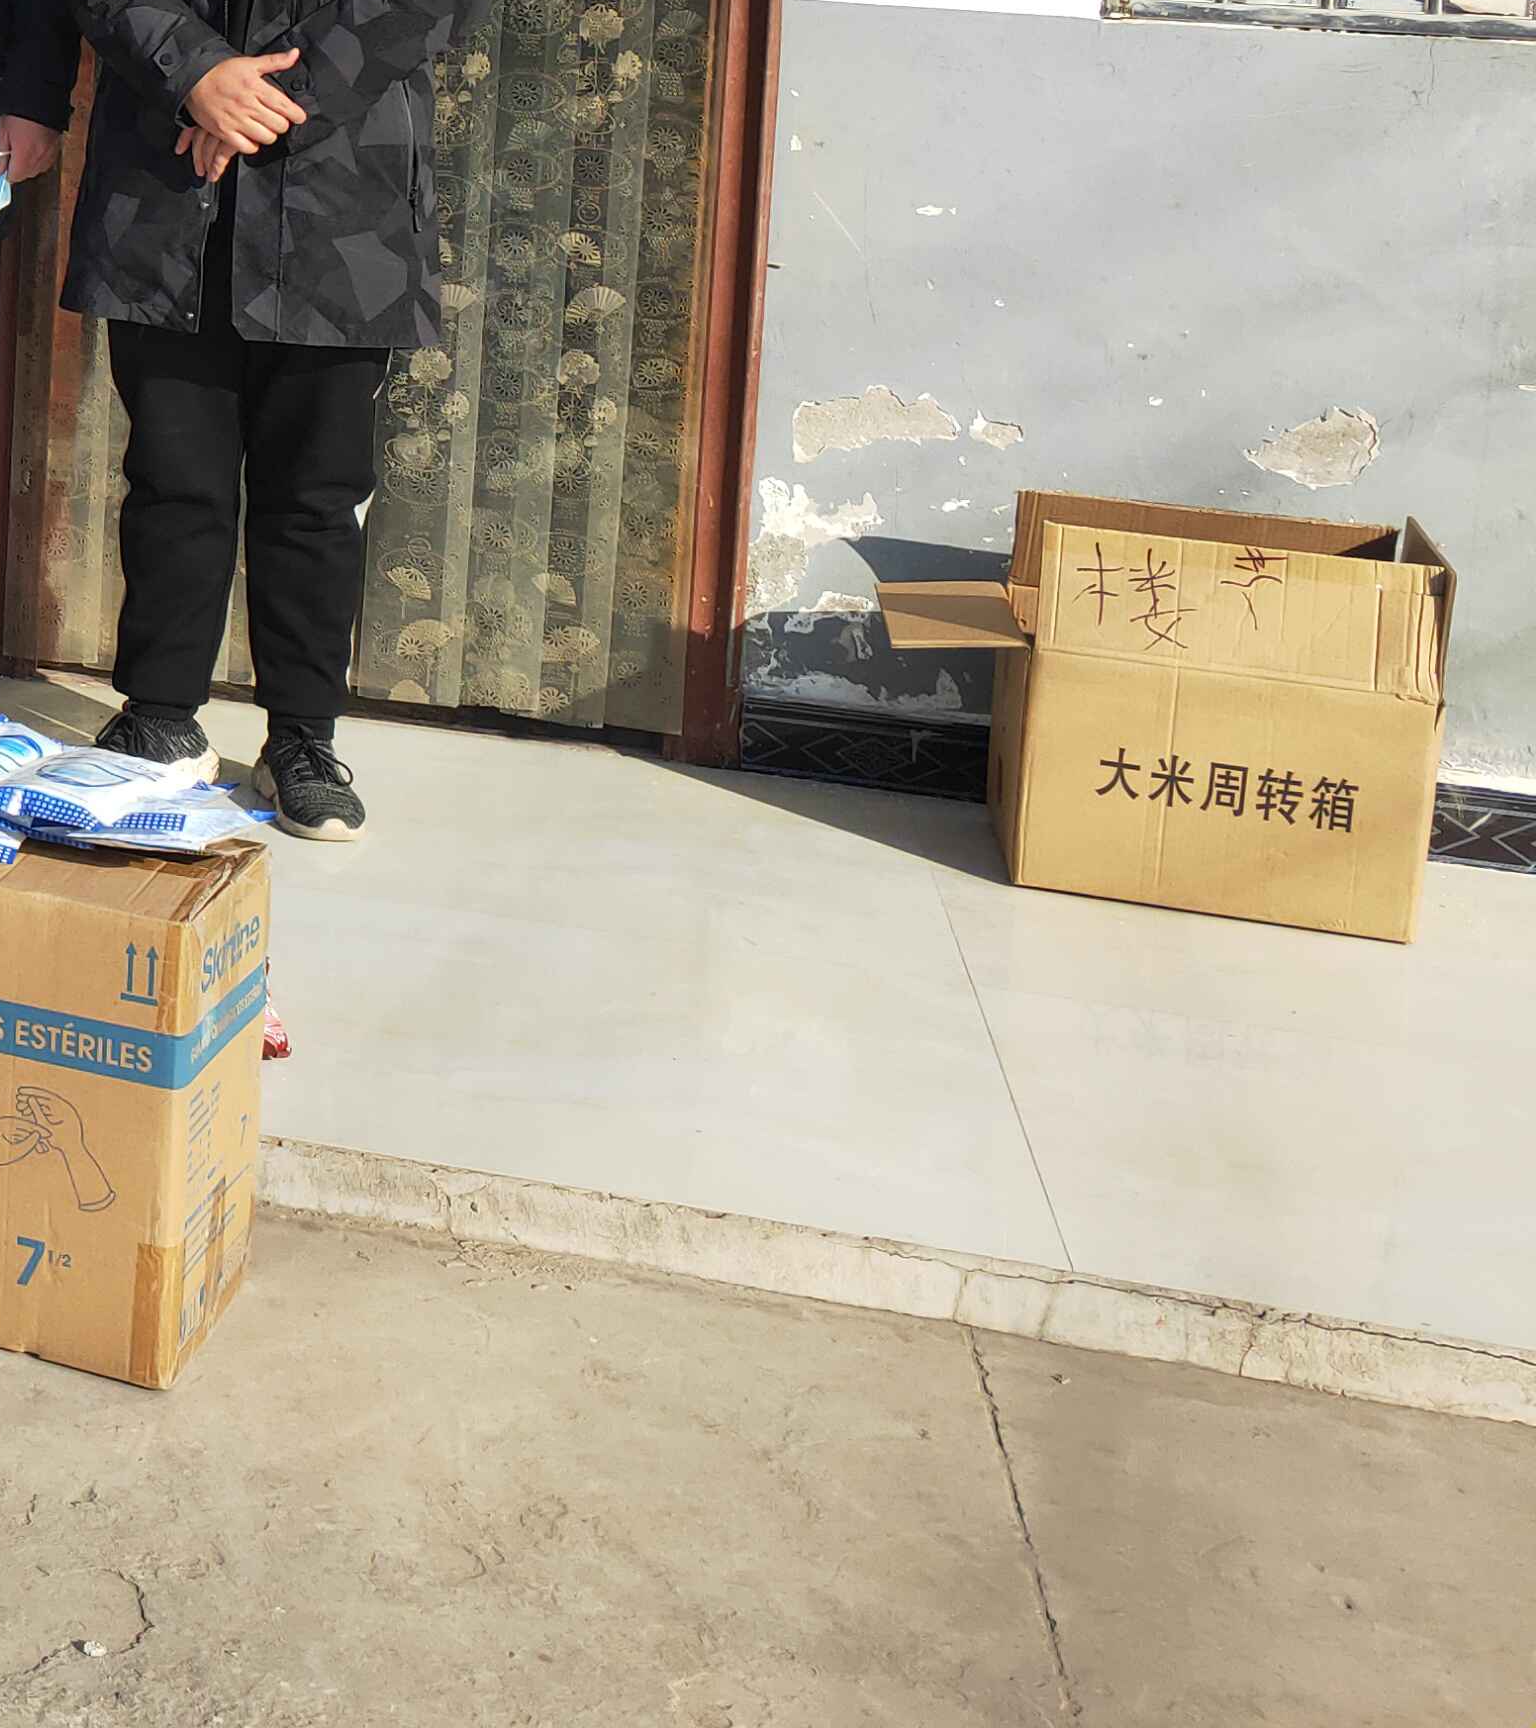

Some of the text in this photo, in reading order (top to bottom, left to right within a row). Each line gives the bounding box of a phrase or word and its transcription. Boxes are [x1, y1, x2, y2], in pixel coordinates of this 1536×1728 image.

[1095, 746, 1360, 834] 大米周转箱
[13, 1018, 154, 1074] ESTÉRILES
[16, 1235, 46, 1286] 7
